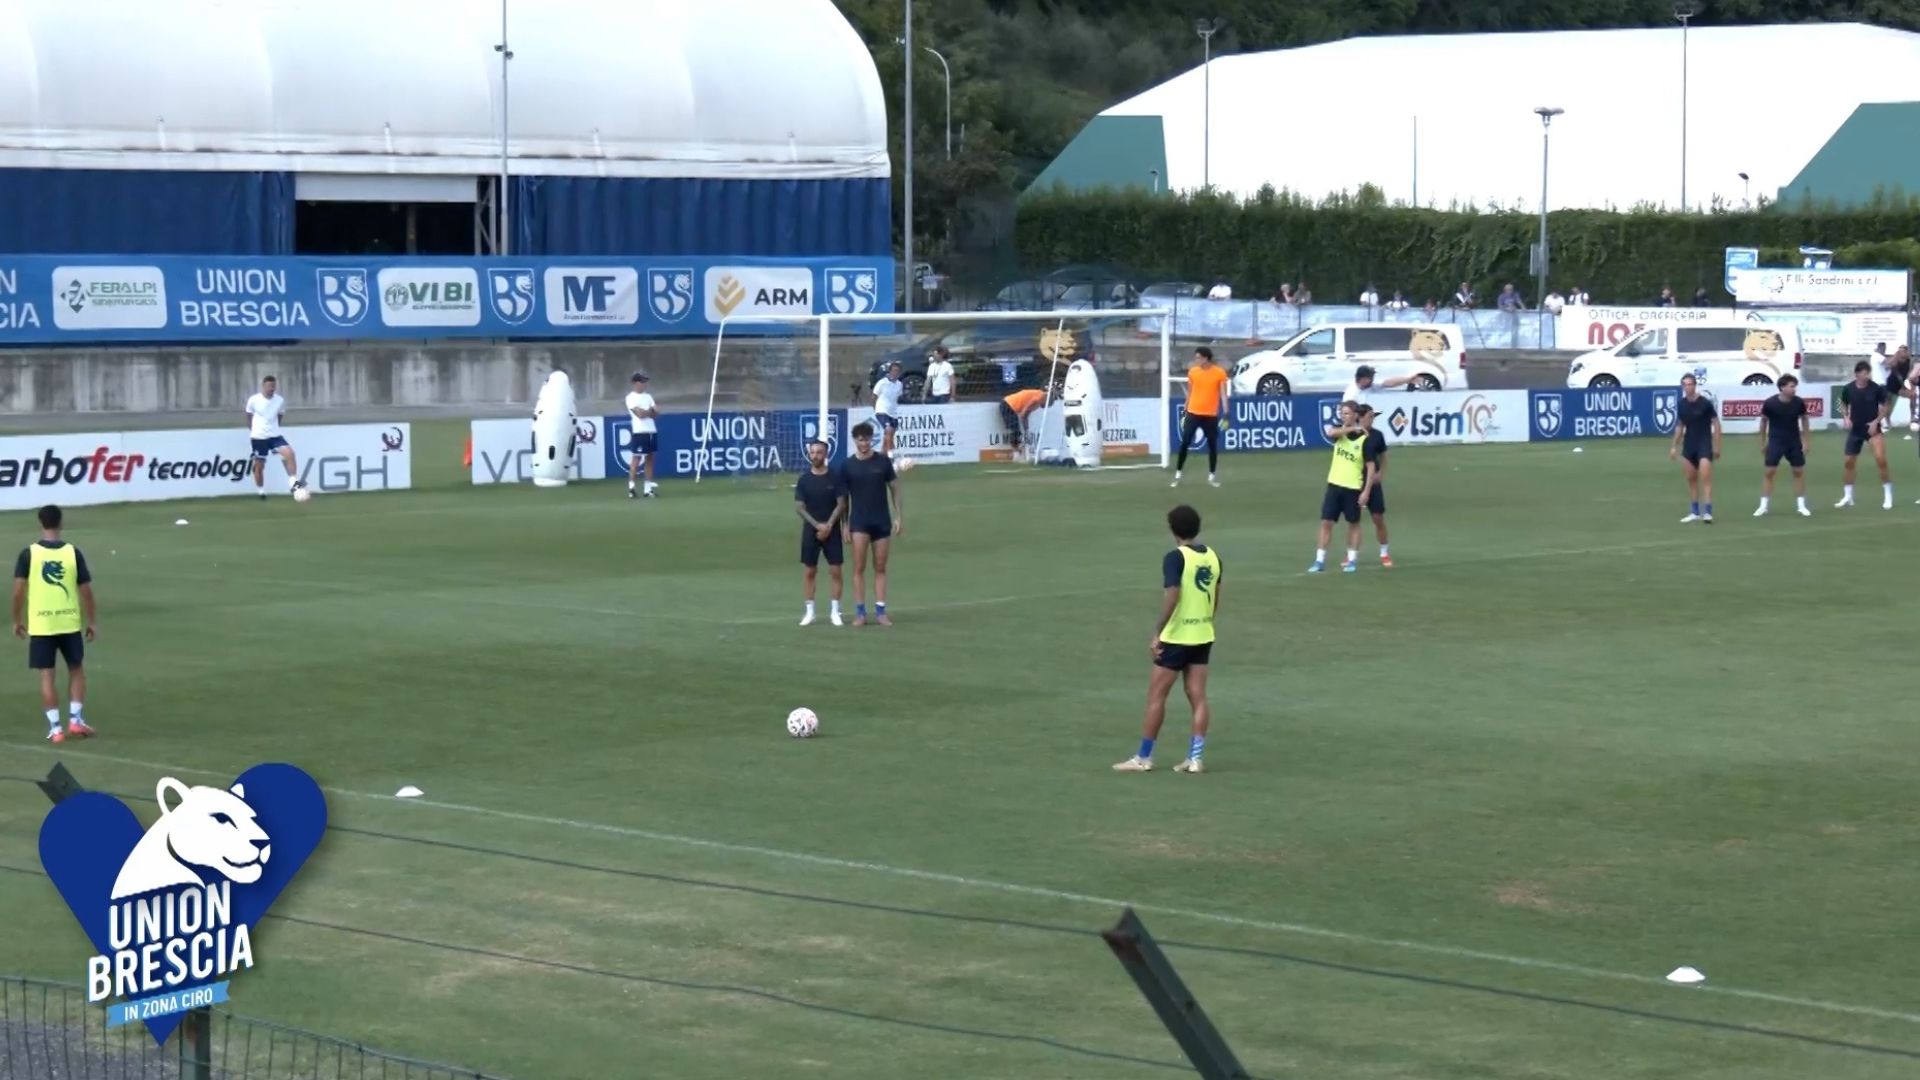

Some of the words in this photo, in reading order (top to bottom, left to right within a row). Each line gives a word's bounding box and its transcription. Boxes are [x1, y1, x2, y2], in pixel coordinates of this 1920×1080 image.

[90, 282, 158, 294] FERALPI
[196, 268, 287, 294] UNION
[562, 276, 616, 312] MF
[754, 288, 808, 306] ARM
[179, 300, 310, 327] BRESCIA
[1588, 309, 1629, 320] OTTICA
[1236, 401, 1293, 422] UNION
[1584, 391, 1632, 412] UNION
[691, 416, 765, 442] UNION
[1224, 426, 1305, 449] BRESCIA
[1575, 416, 1642, 437] BRESCIA
[895, 431, 955, 449] MBIENTE
[148, 454, 257, 482] tecnologi
[676, 446, 782, 473] BRESCIA
